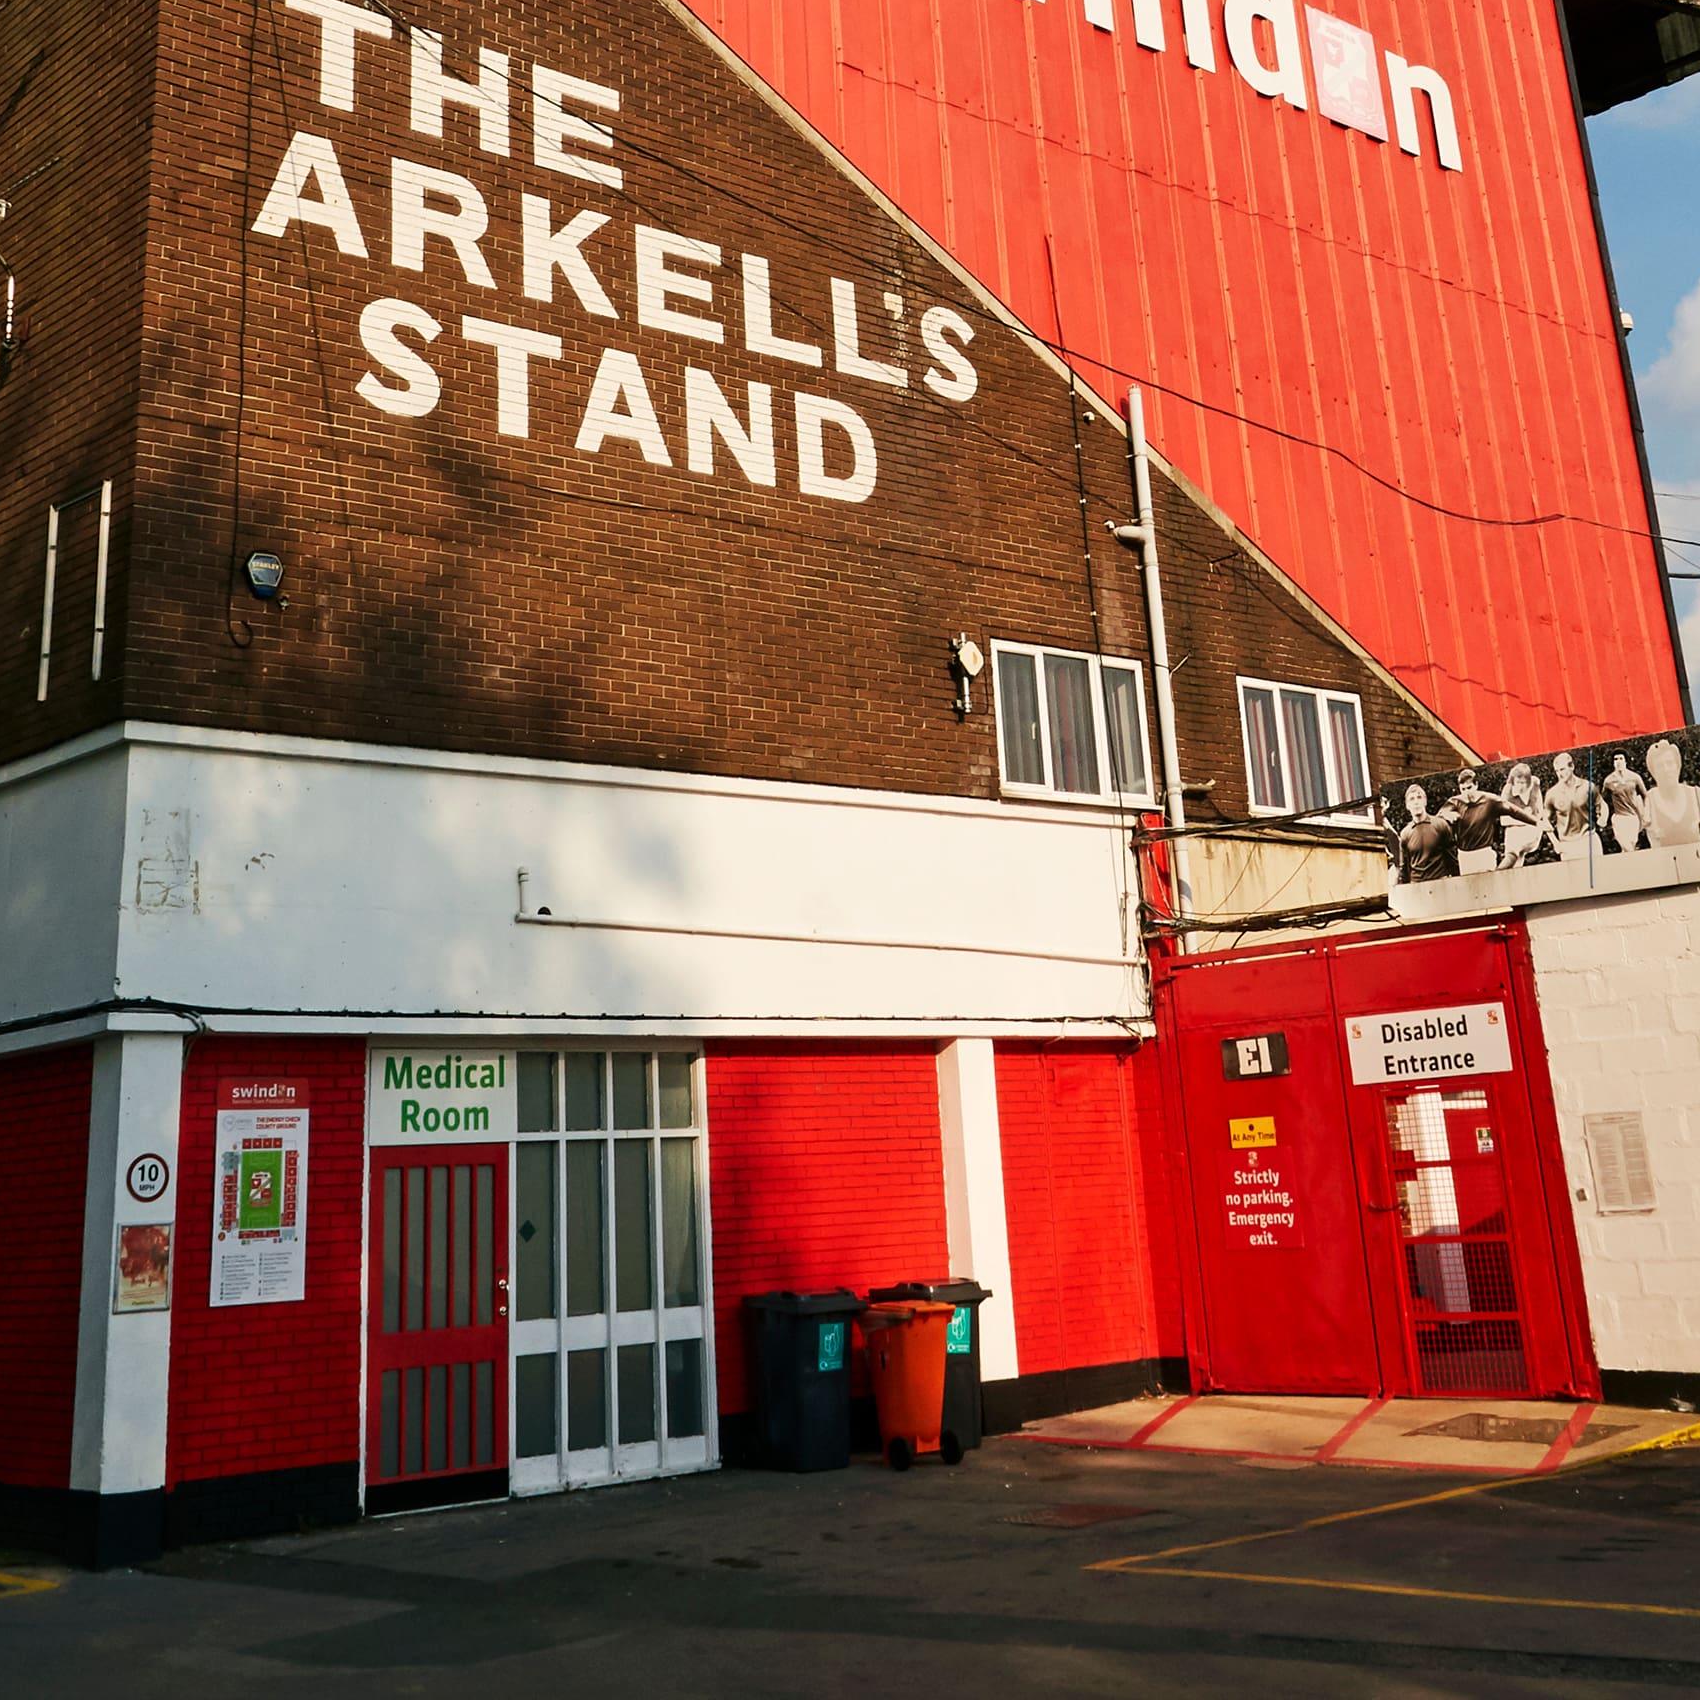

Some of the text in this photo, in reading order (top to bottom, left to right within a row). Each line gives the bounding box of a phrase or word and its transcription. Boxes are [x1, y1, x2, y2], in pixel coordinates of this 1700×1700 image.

[251, 131, 980, 402] ARKELL'S
[354, 297, 878, 504] STAND
[1381, 1015, 1469, 1044] Disabled
[1384, 1050, 1476, 1076] Entrance
[383, 1055, 506, 1091] Medical
[231, 1083, 296, 1098] swindn
[400, 1099, 490, 1133] Room
[1232, 1131, 1276, 1143] At Any Time
[137, 1163, 159, 1182] 10
[1234, 1169, 1280, 1187] Strictly
[138, 1184, 156, 1192] MPH
[1226, 1190, 1294, 1208] no parking.
[1228, 1211, 1295, 1229] Emergency
[1249, 1232, 1278, 1246] exit.
